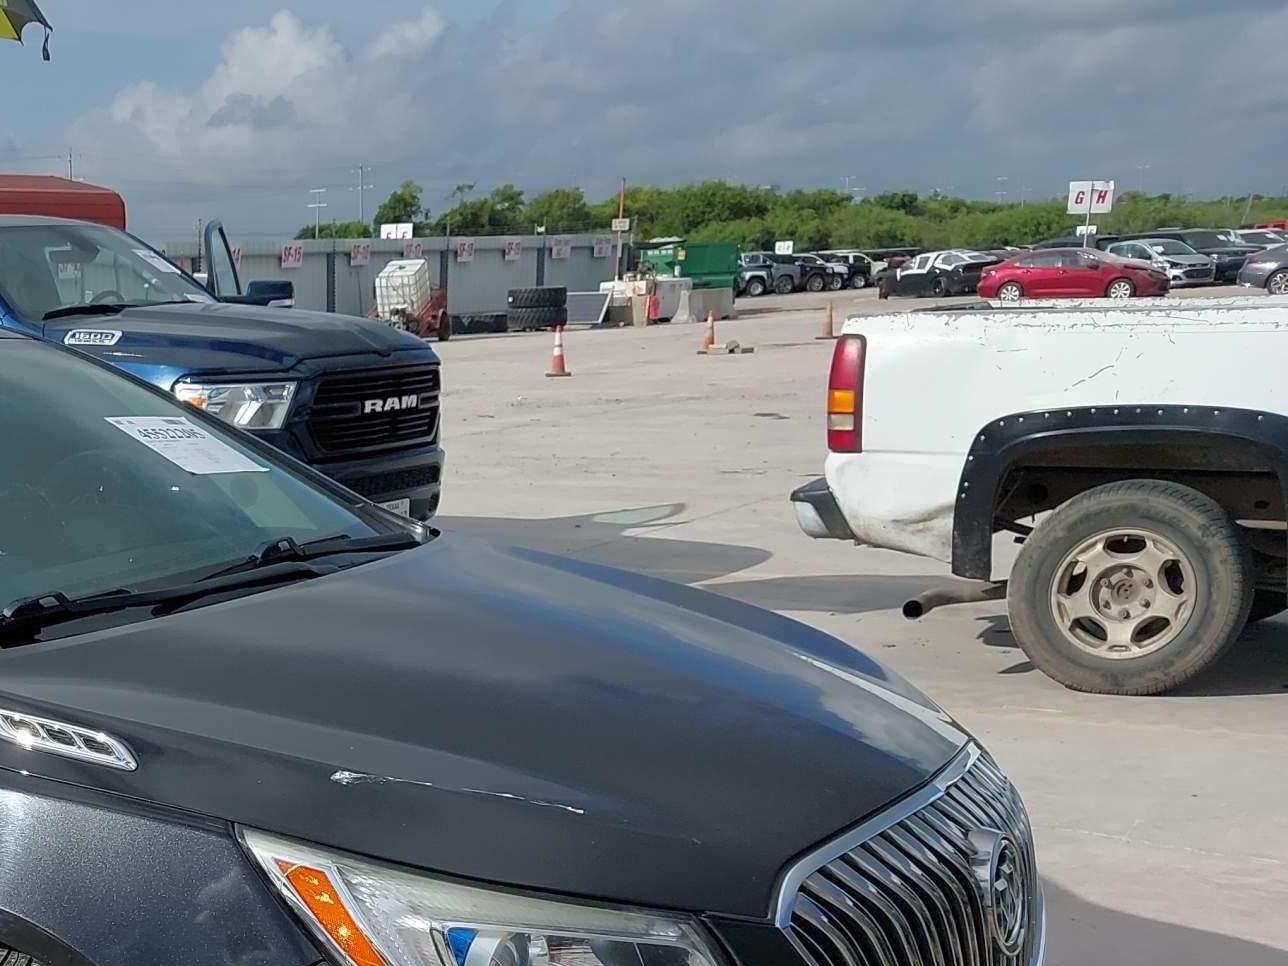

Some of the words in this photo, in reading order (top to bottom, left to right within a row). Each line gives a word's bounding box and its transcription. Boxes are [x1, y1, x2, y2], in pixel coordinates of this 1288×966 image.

[1074, 190, 1086, 205] G
[1096, 190, 1108, 204] H
[363, 394, 418, 414] RAM
